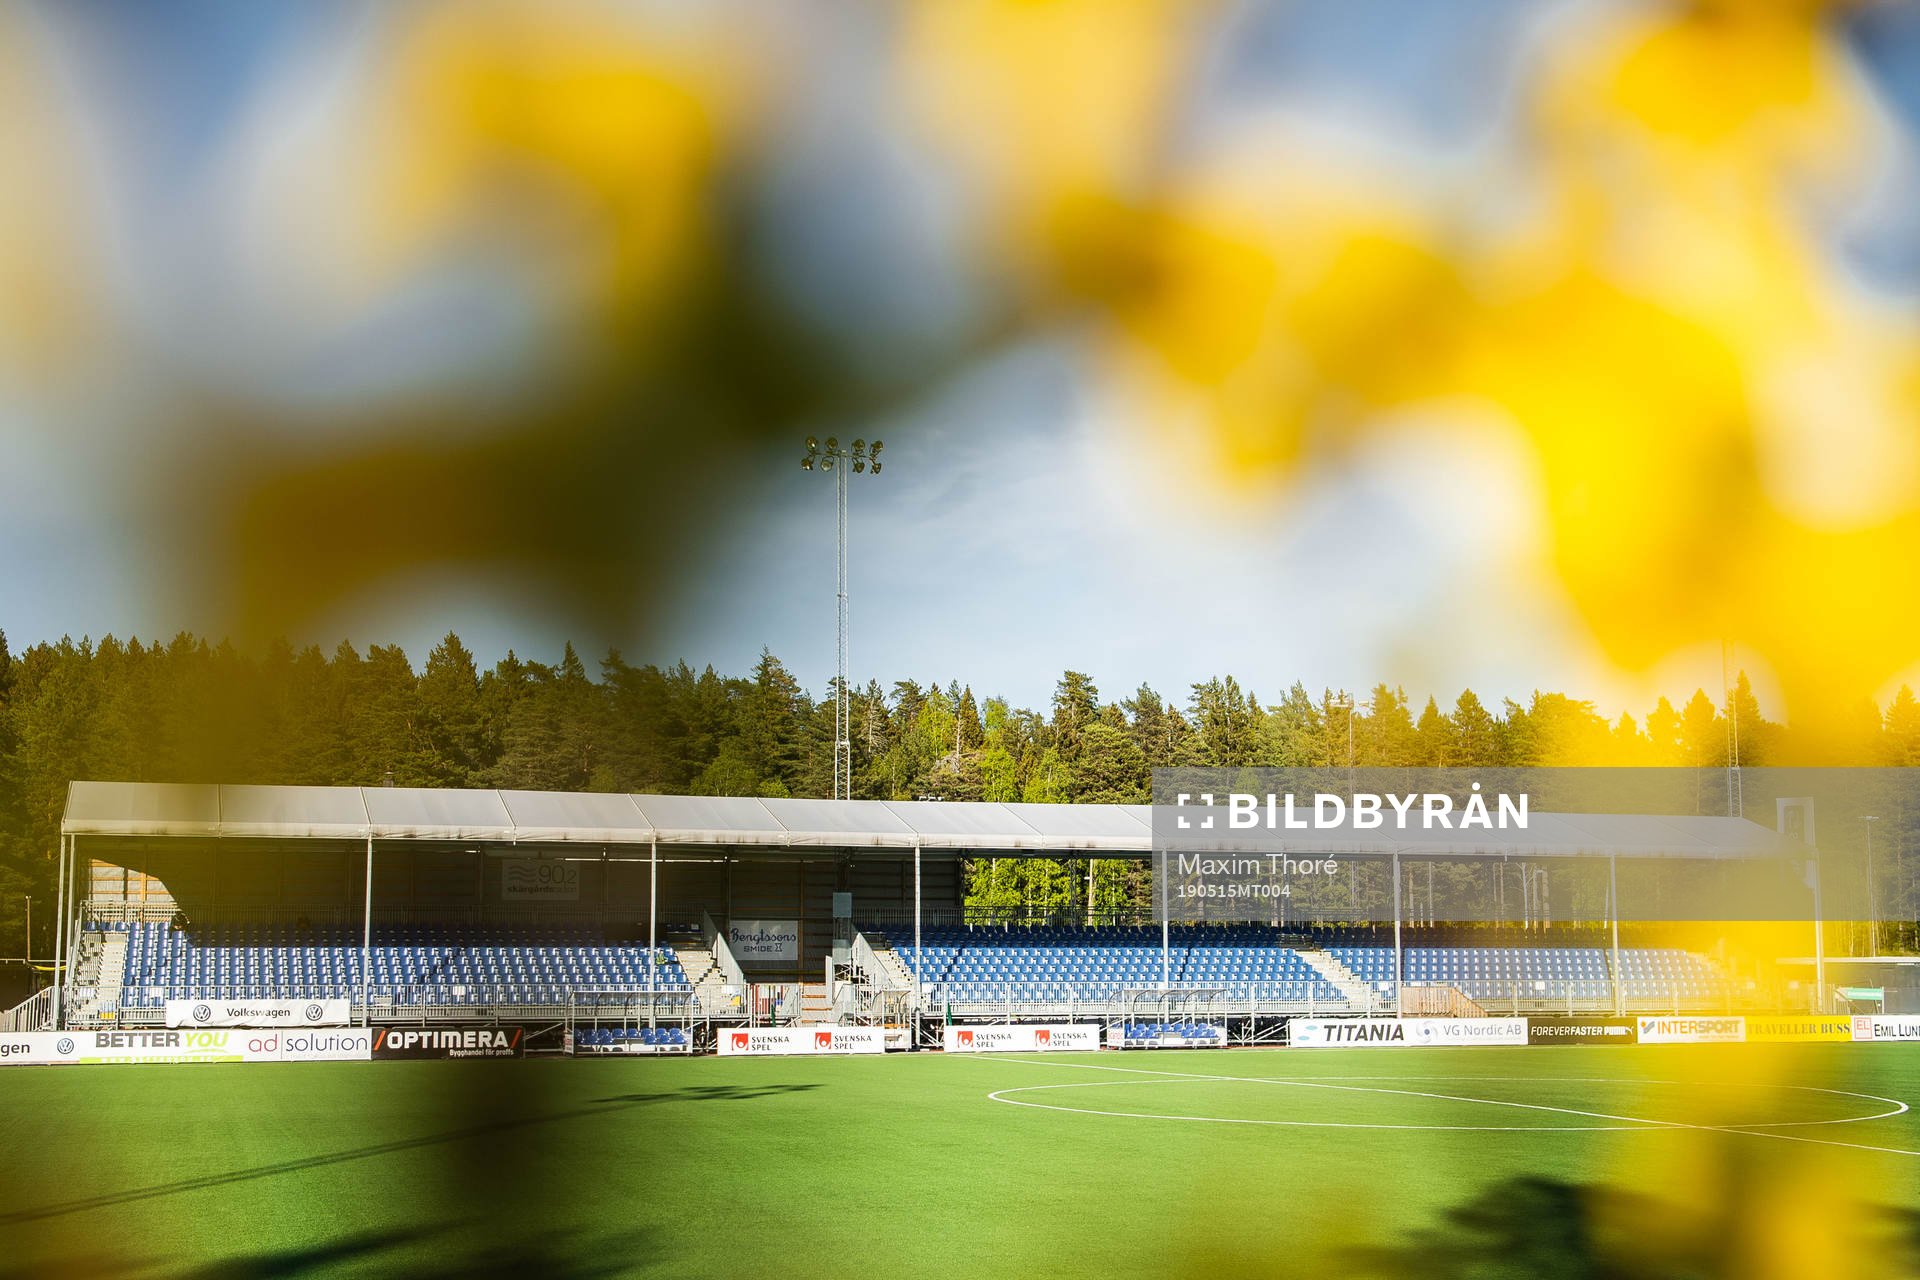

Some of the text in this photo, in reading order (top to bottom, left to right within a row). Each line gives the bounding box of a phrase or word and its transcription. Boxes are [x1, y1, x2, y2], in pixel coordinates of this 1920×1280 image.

[730, 927, 797, 945] Bengtssons
[743, 945, 773, 953] SMIDE
[226, 1007, 291, 1018] Volkswagen
[1443, 1023, 1522, 1036] VG Nordic AB
[1657, 1020, 1740, 1034] INTERSPORT
[1747, 1023, 1851, 1035] TRAVELLER BUSS
[1856, 1020, 1870, 1030] EL
[1323, 1024, 1405, 1042] TITANIA
[95, 1031, 230, 1048] BETTER YOU
[248, 1033, 369, 1052] ad solution
[386, 1030, 509, 1049] OPTIMERA
[976, 1040, 995, 1048] SPEL
[1053, 1039, 1071, 1047] SPEL
[751, 1043, 771, 1051] SPEL
[834, 1042, 854, 1050] SPEL
[449, 1048, 514, 1058] Bygghandel för proffs
